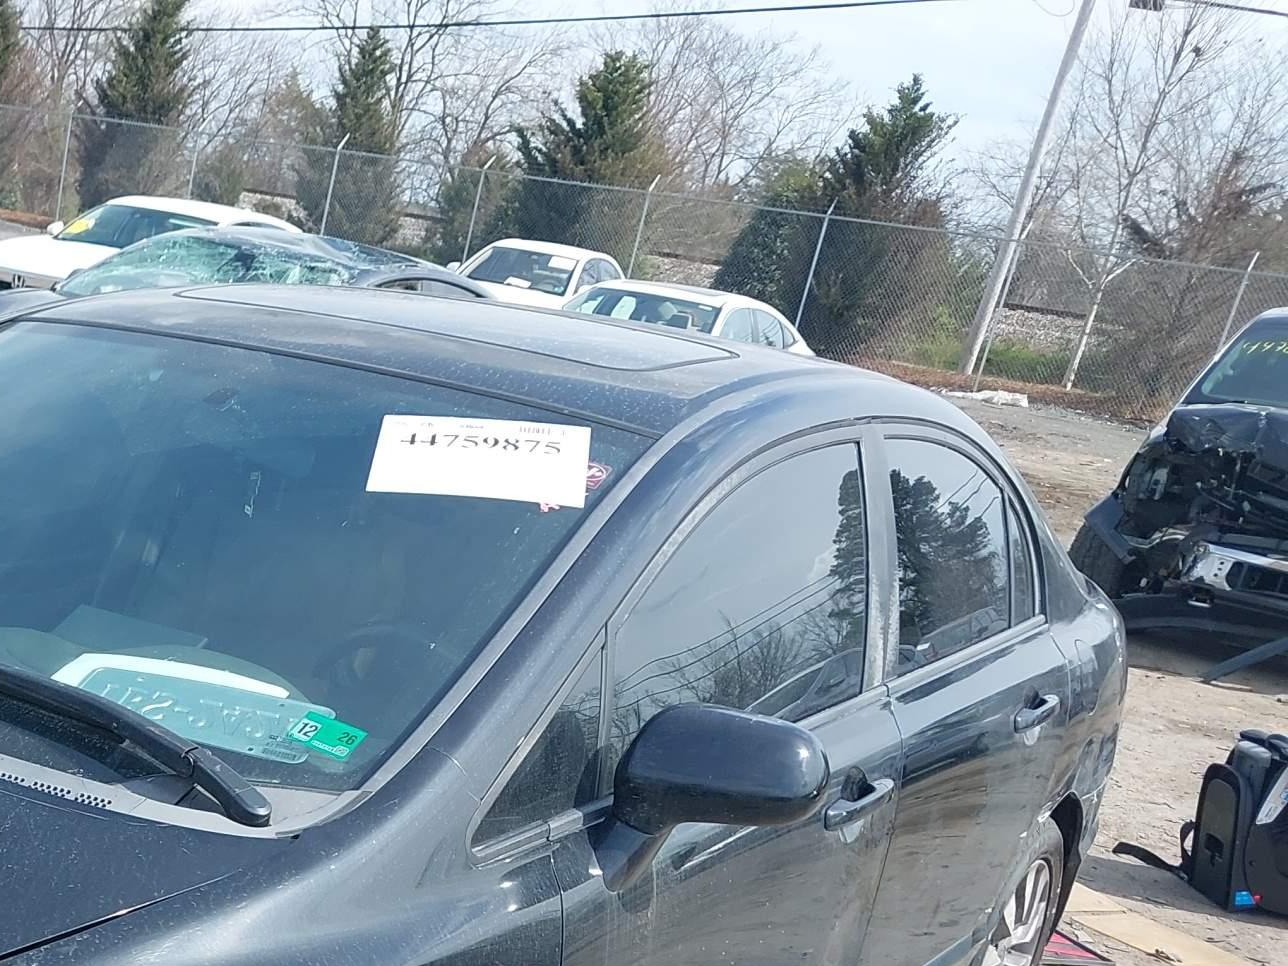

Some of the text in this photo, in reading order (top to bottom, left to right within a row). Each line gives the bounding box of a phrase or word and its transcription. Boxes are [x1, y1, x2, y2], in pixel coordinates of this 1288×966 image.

[400, 432, 561, 455] 44759875
[297, 721, 358, 746] 12 26
